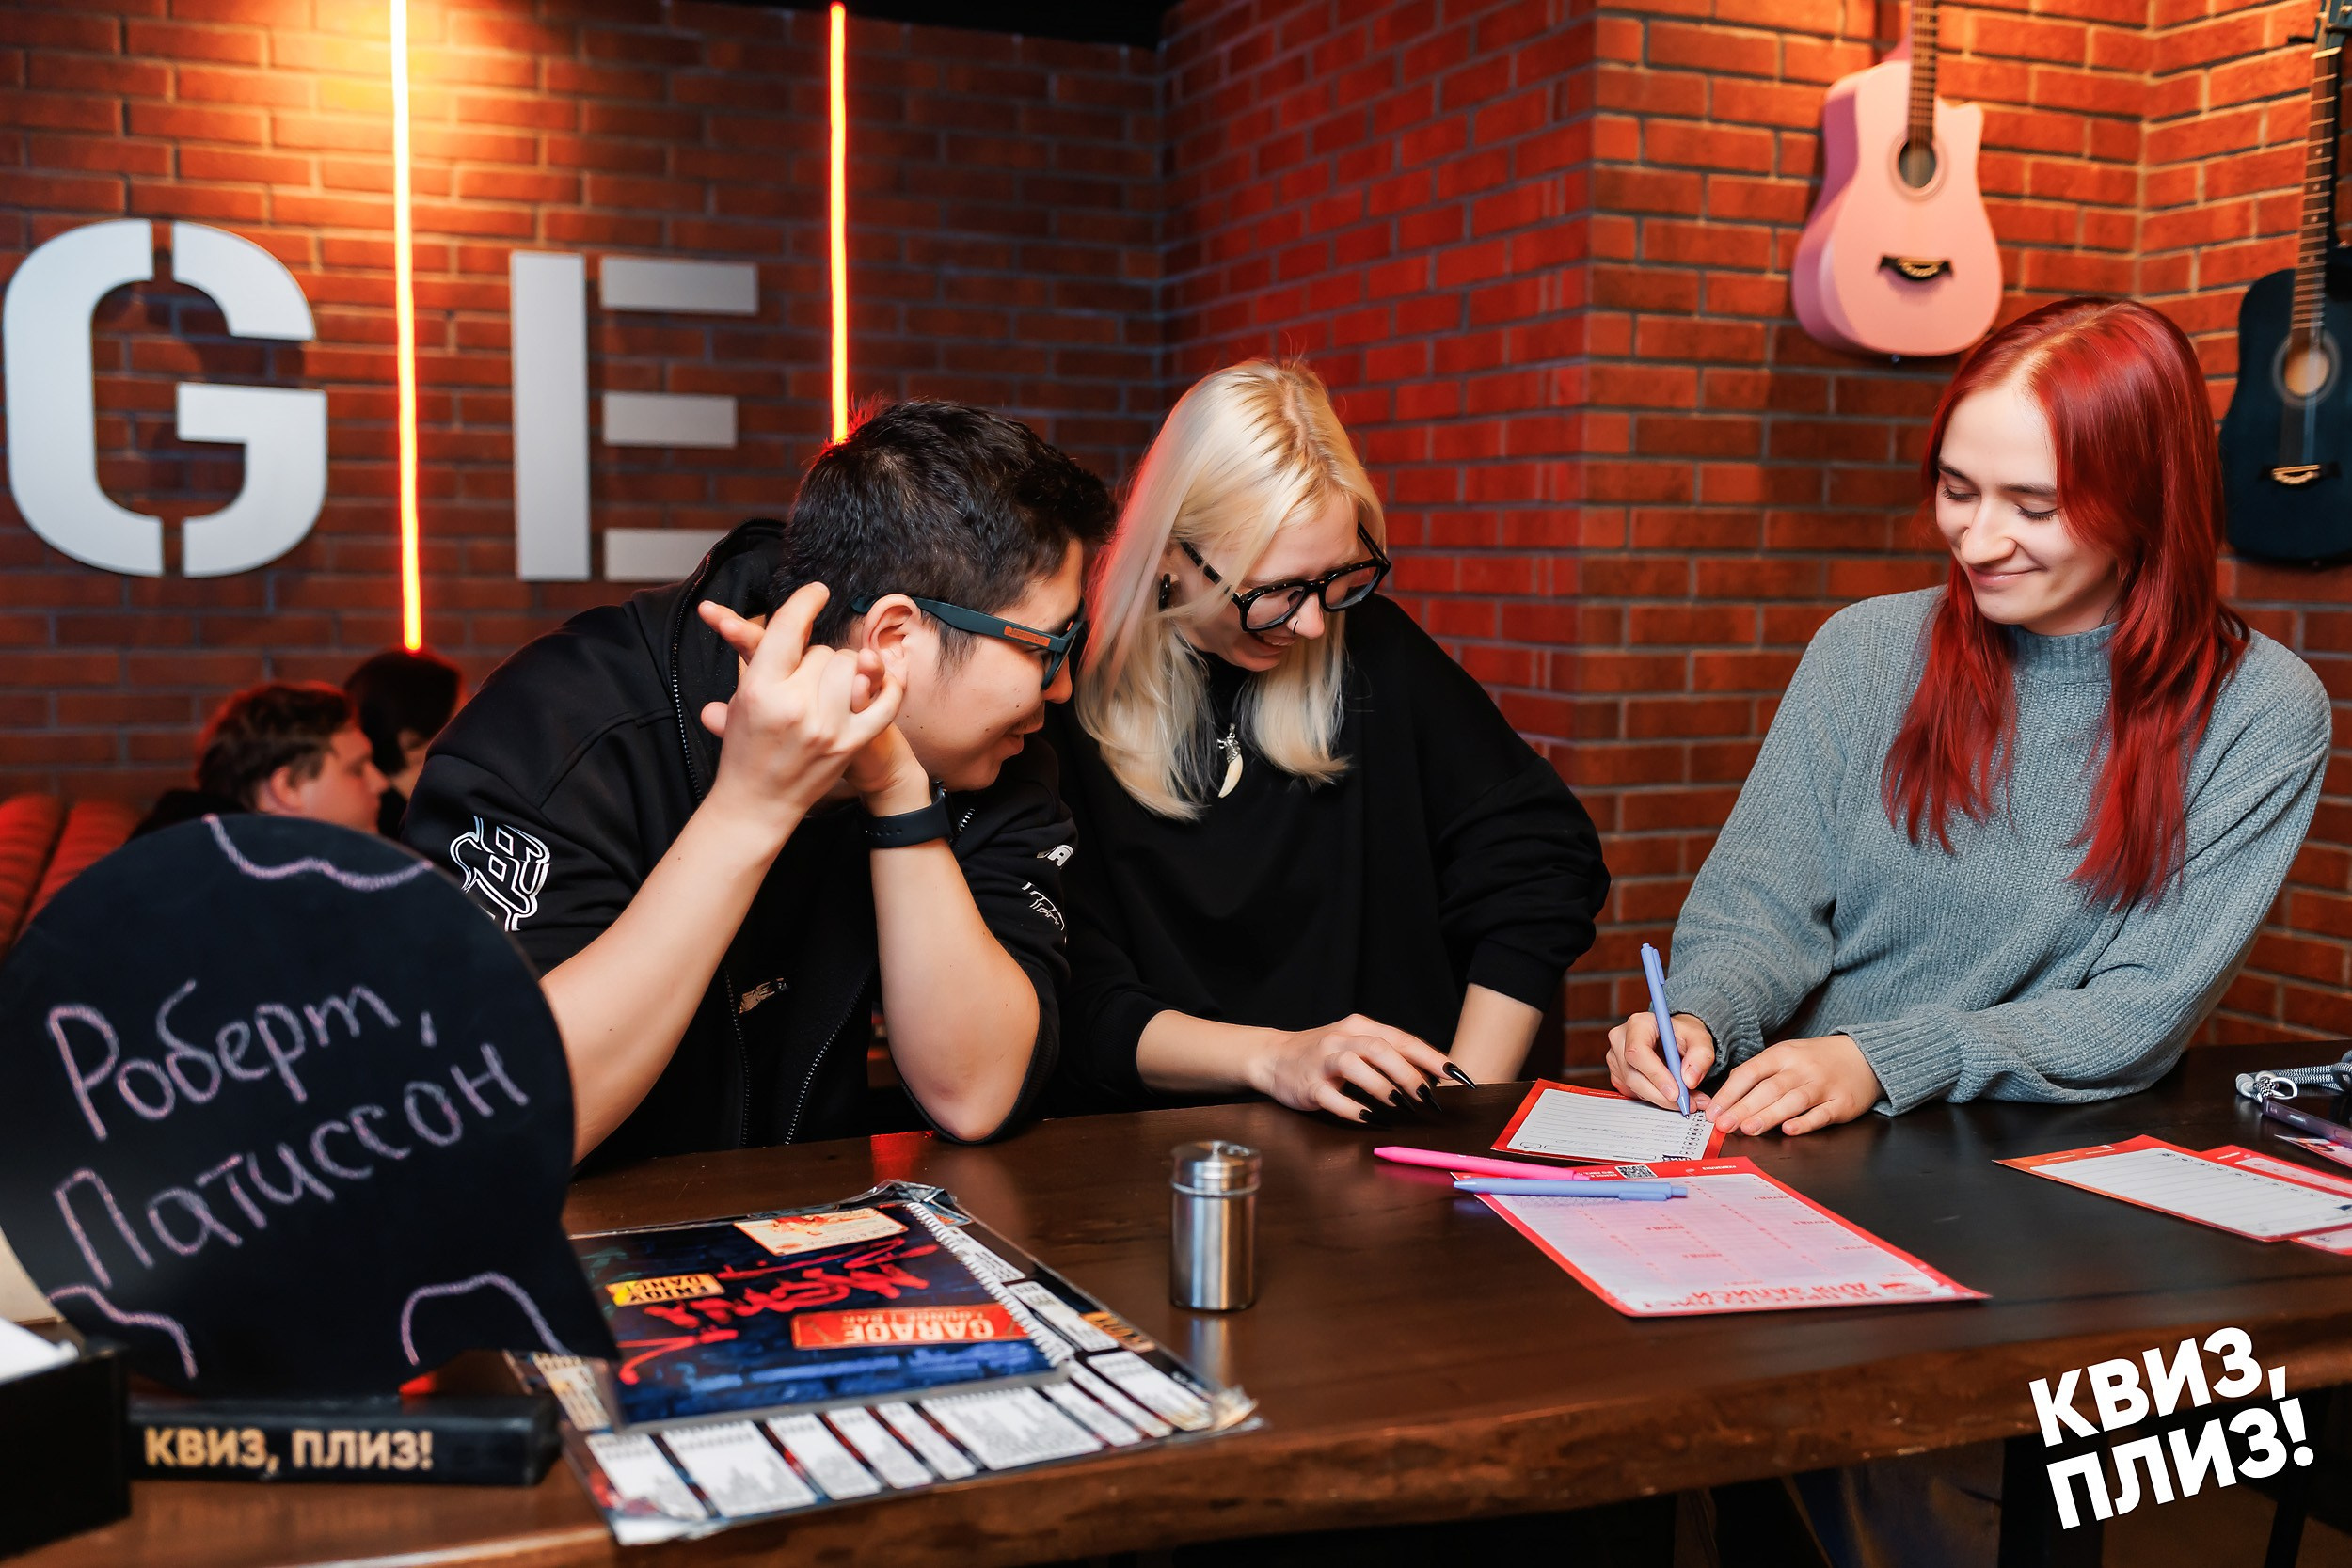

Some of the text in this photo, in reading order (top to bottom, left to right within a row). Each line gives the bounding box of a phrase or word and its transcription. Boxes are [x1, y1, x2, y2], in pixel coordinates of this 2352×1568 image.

[47, 980, 437, 1140] Роберт,
[53, 1044, 529, 1289] Патиссон
[843, 1318, 995, 1345] GARAGE
[144, 1427, 434, 1480] КВИЗ, ПЛИЗ!
